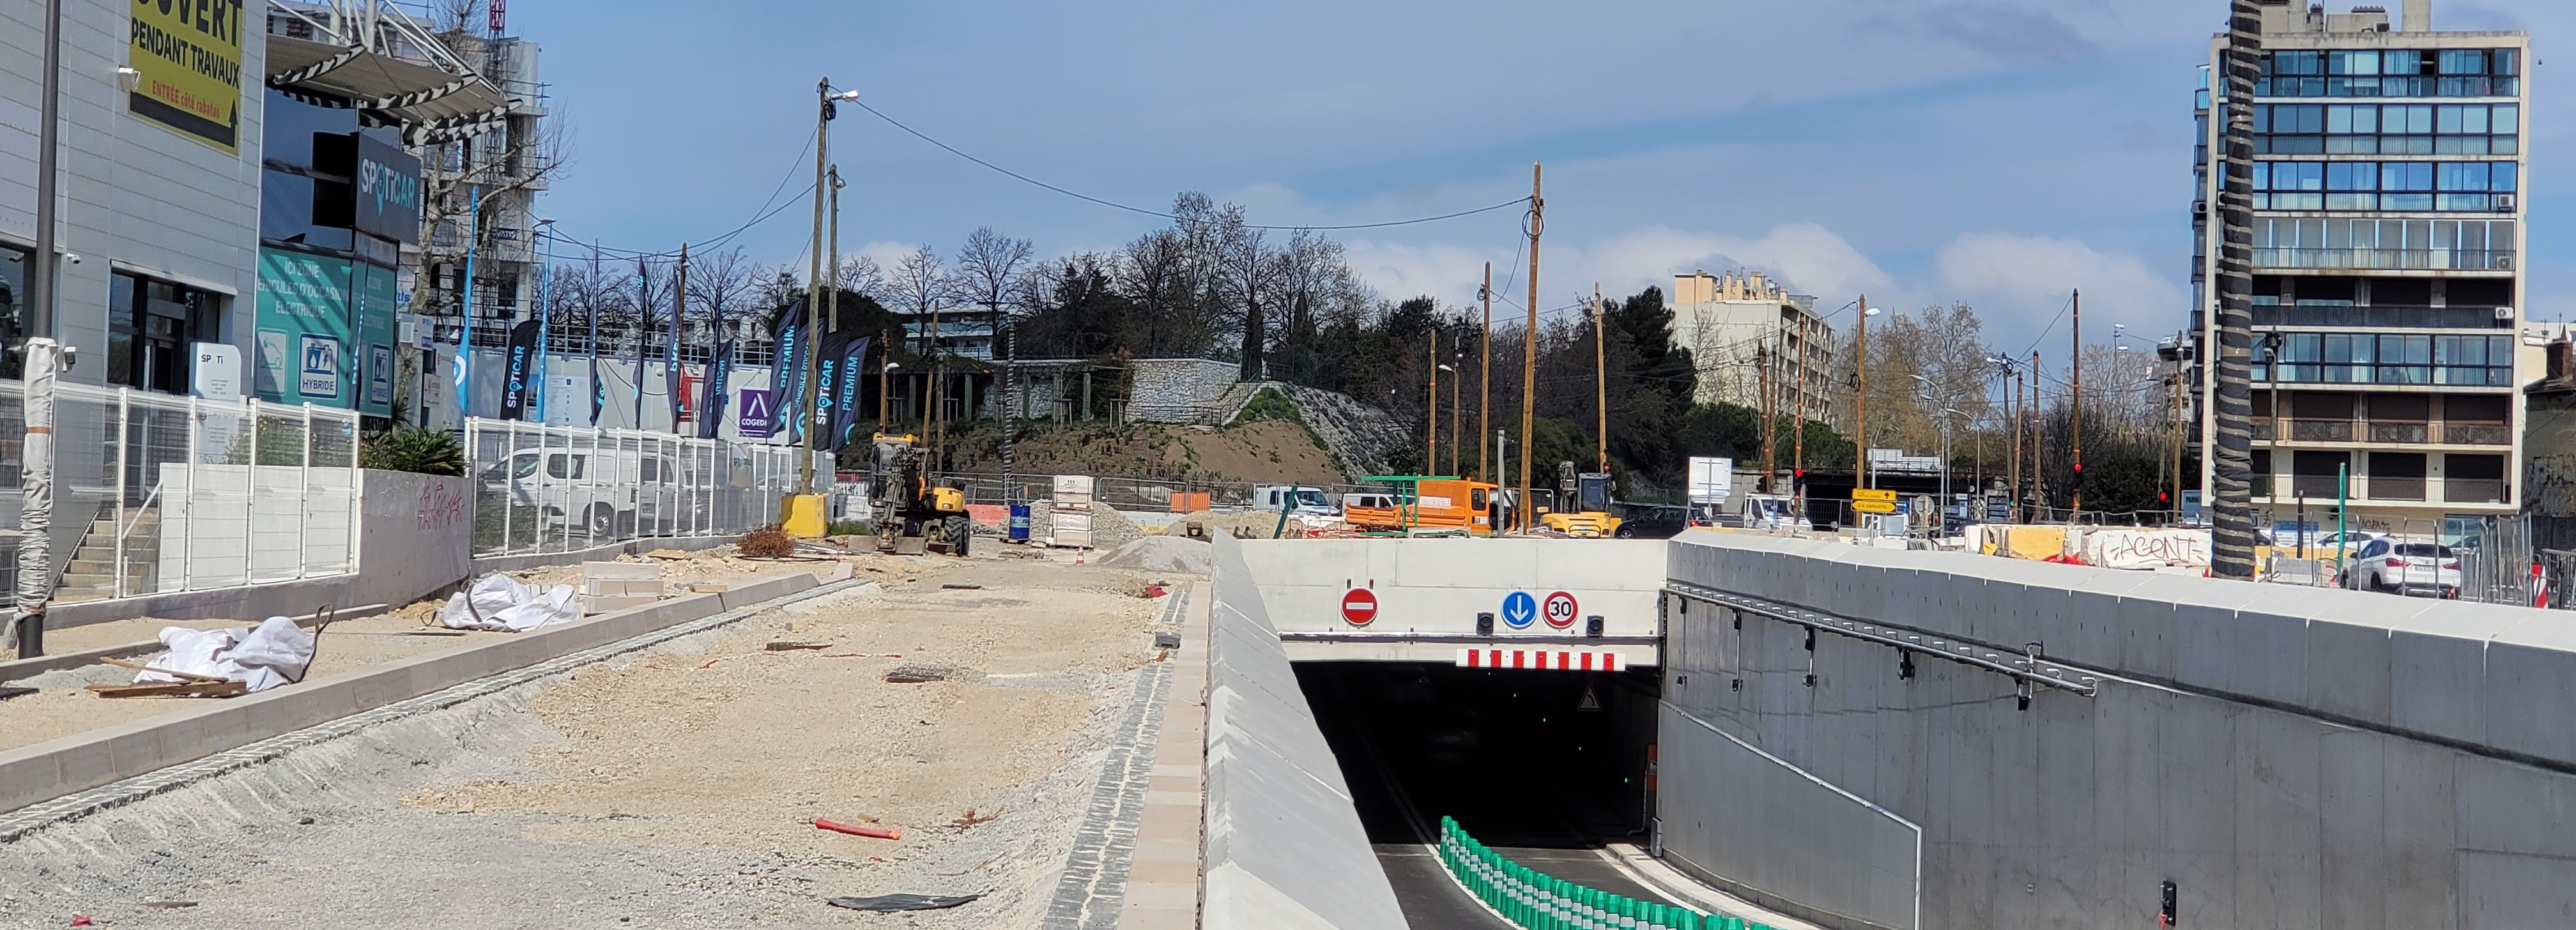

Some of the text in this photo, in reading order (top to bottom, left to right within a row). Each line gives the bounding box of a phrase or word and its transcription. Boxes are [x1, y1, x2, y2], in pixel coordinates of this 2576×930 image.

[135, 0, 242, 47] VERT
[132, 17, 240, 89] PENDANT TRAVAUX
[152, 80, 179, 104] ENTRÉE
[181, 91, 194, 109] côté
[284, 261, 319, 278] ICI ZONE
[257, 277, 298, 295] EHICULES
[300, 283, 349, 302] D'OCCASION
[780, 324, 795, 388] PREMIUM
[302, 379, 335, 391] HYBRIDE
[842, 356, 858, 411] PREMIUM
[741, 418, 767, 427] COGEDI
[1550, 601, 1572, 616] 30
